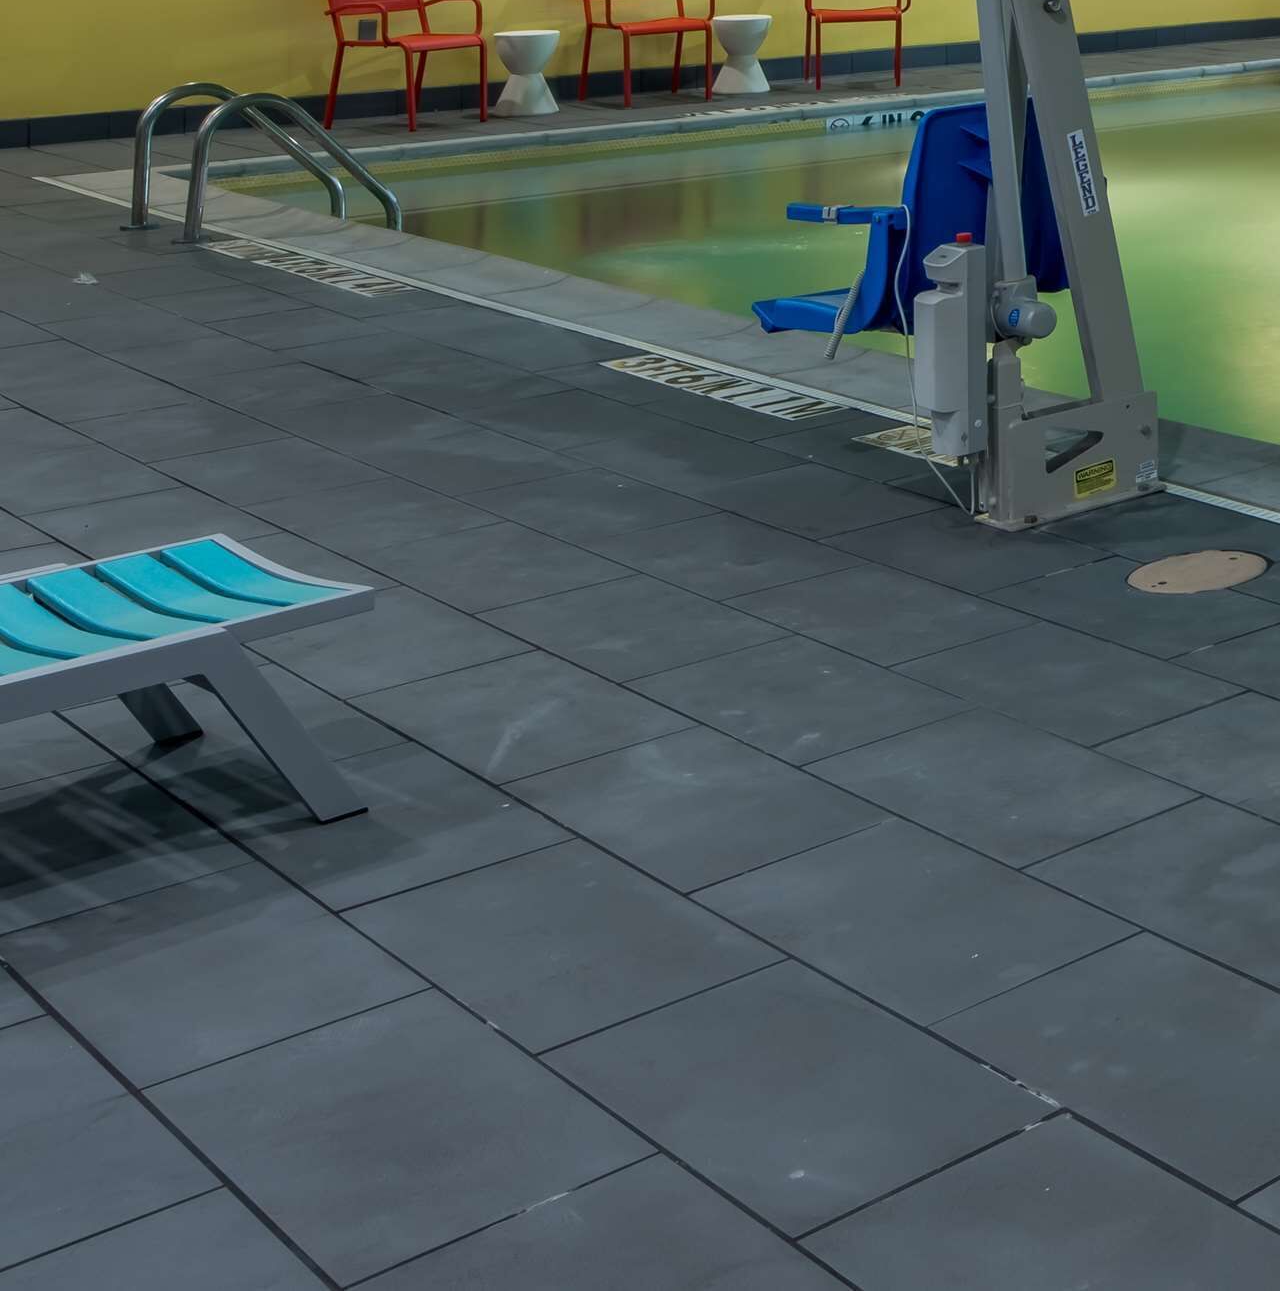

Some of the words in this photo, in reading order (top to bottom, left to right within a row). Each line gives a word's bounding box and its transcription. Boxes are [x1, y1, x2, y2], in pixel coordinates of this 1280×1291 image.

[882, 113, 902, 125] IN
[1070, 134, 1096, 210] LEGEND
[634, 362, 700, 378] FT
[665, 373, 722, 385] 6
[685, 378, 752, 394] IN
[770, 401, 844, 419] M
